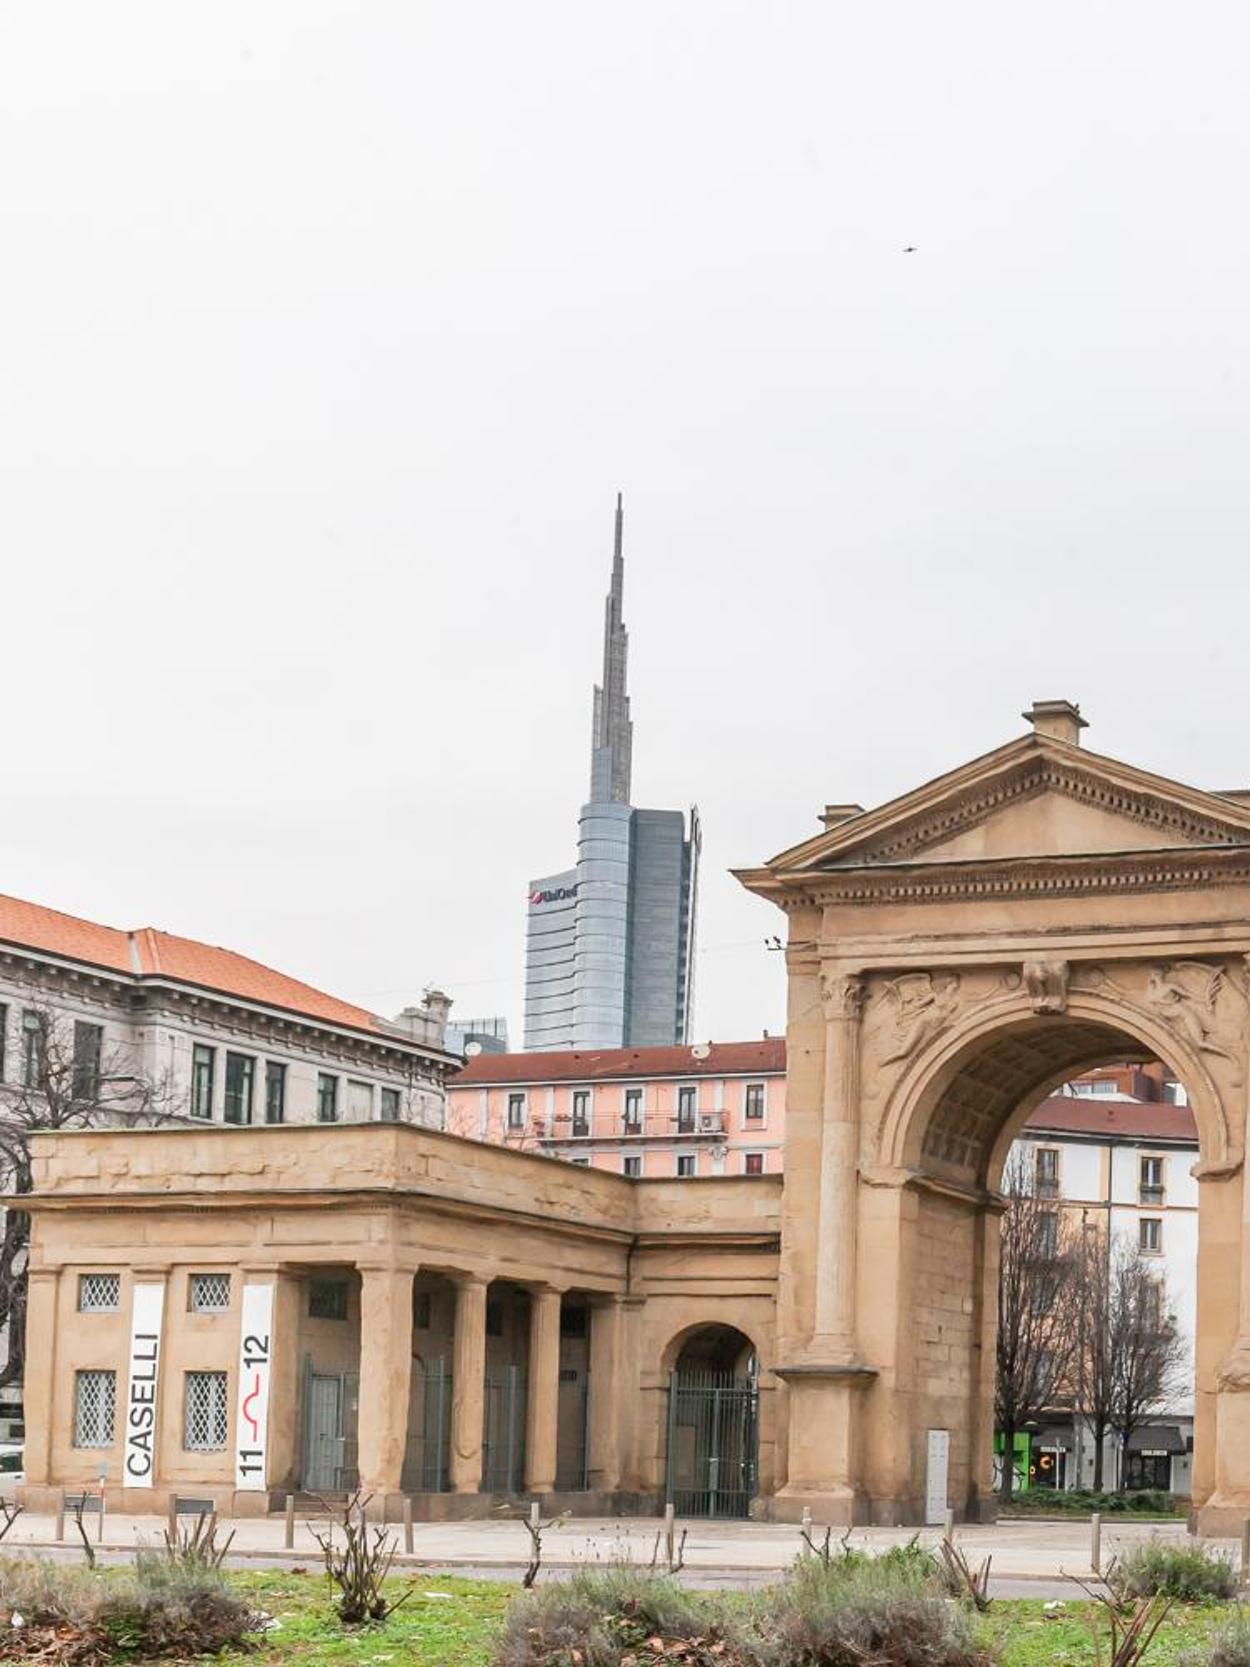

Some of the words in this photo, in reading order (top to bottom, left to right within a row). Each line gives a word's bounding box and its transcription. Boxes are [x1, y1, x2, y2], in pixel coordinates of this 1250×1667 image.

[243, 1335, 269, 1369] 12
[127, 1334, 158, 1477] CASELLI
[239, 1450, 263, 1477] 11
